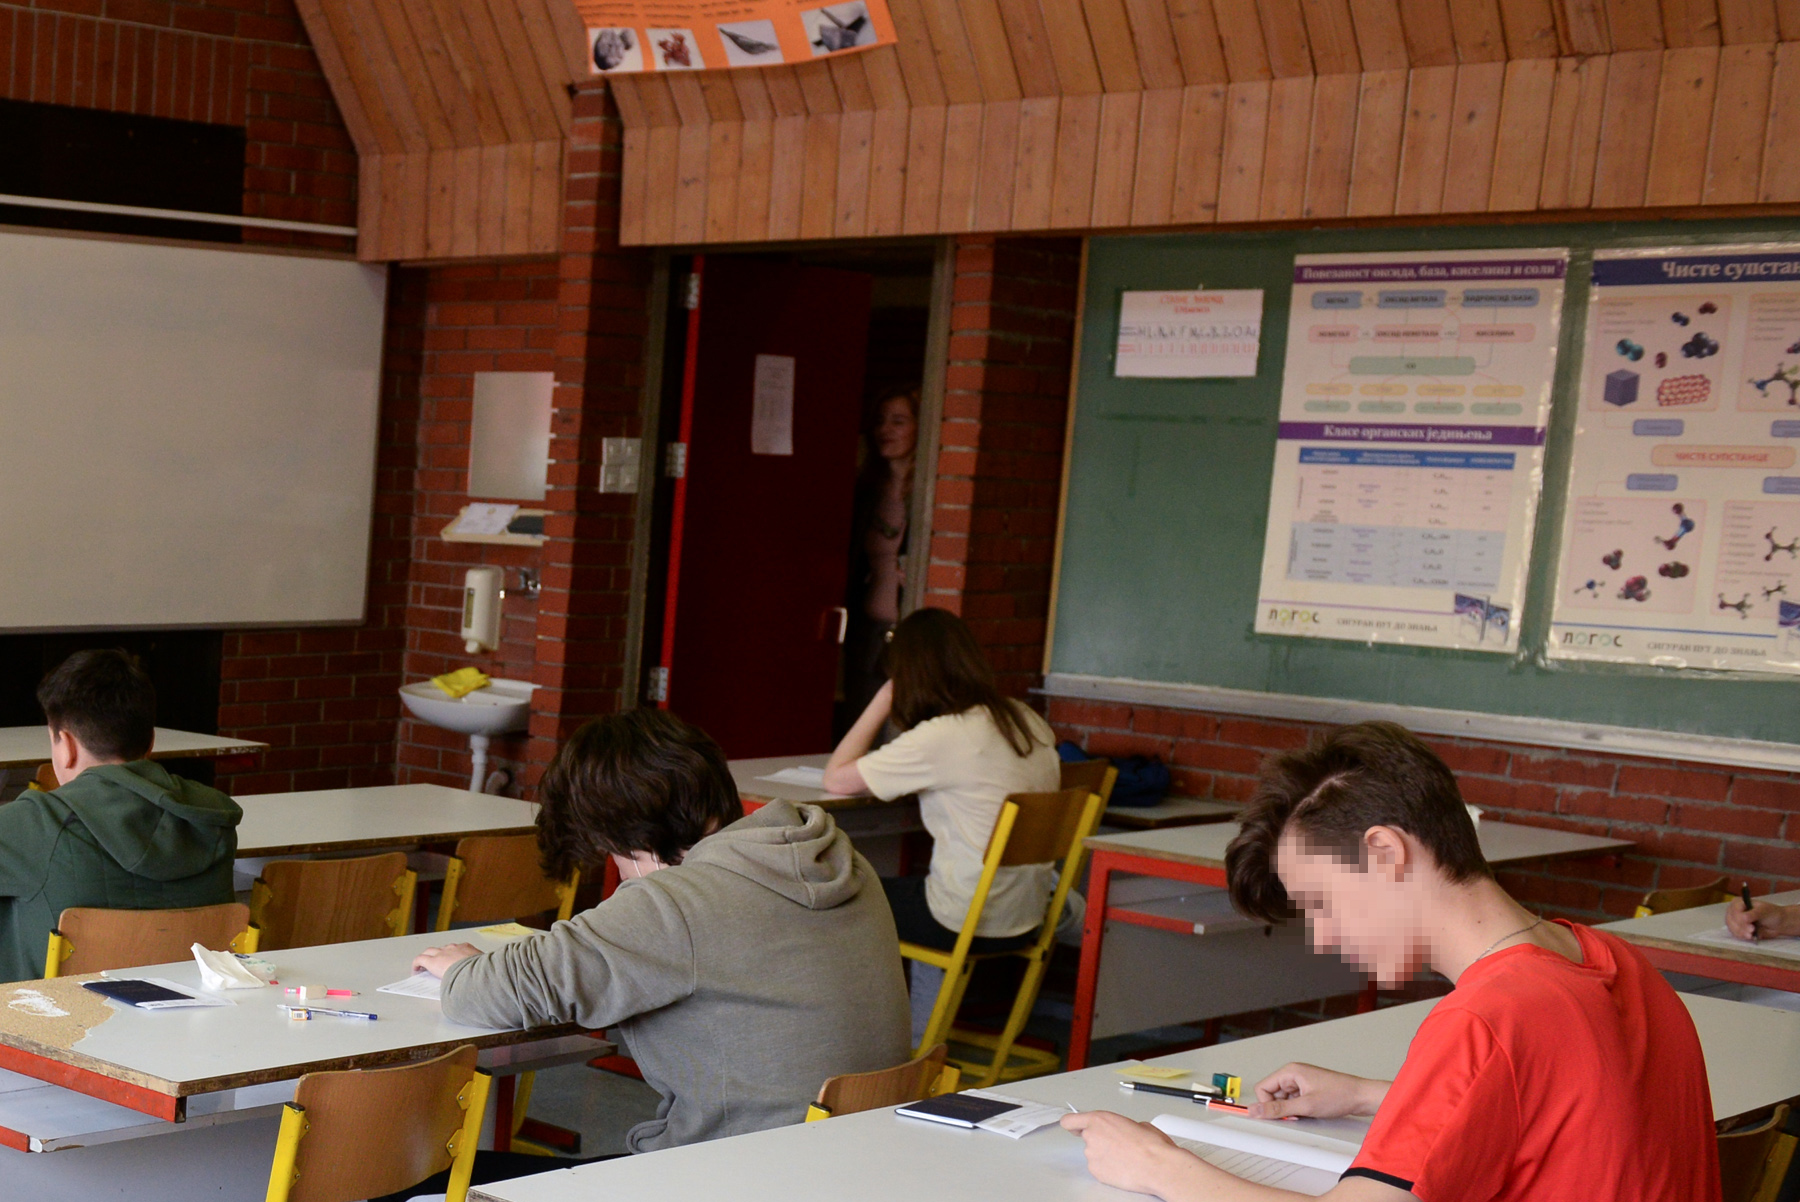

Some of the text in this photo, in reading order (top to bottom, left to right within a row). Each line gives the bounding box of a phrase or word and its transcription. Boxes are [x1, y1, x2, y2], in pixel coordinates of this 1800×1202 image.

[1524, 265, 1554, 275] соли
[1662, 261, 1800, 280] Чисте супстан
[1323, 425, 1492, 440] Класе органских једињења
